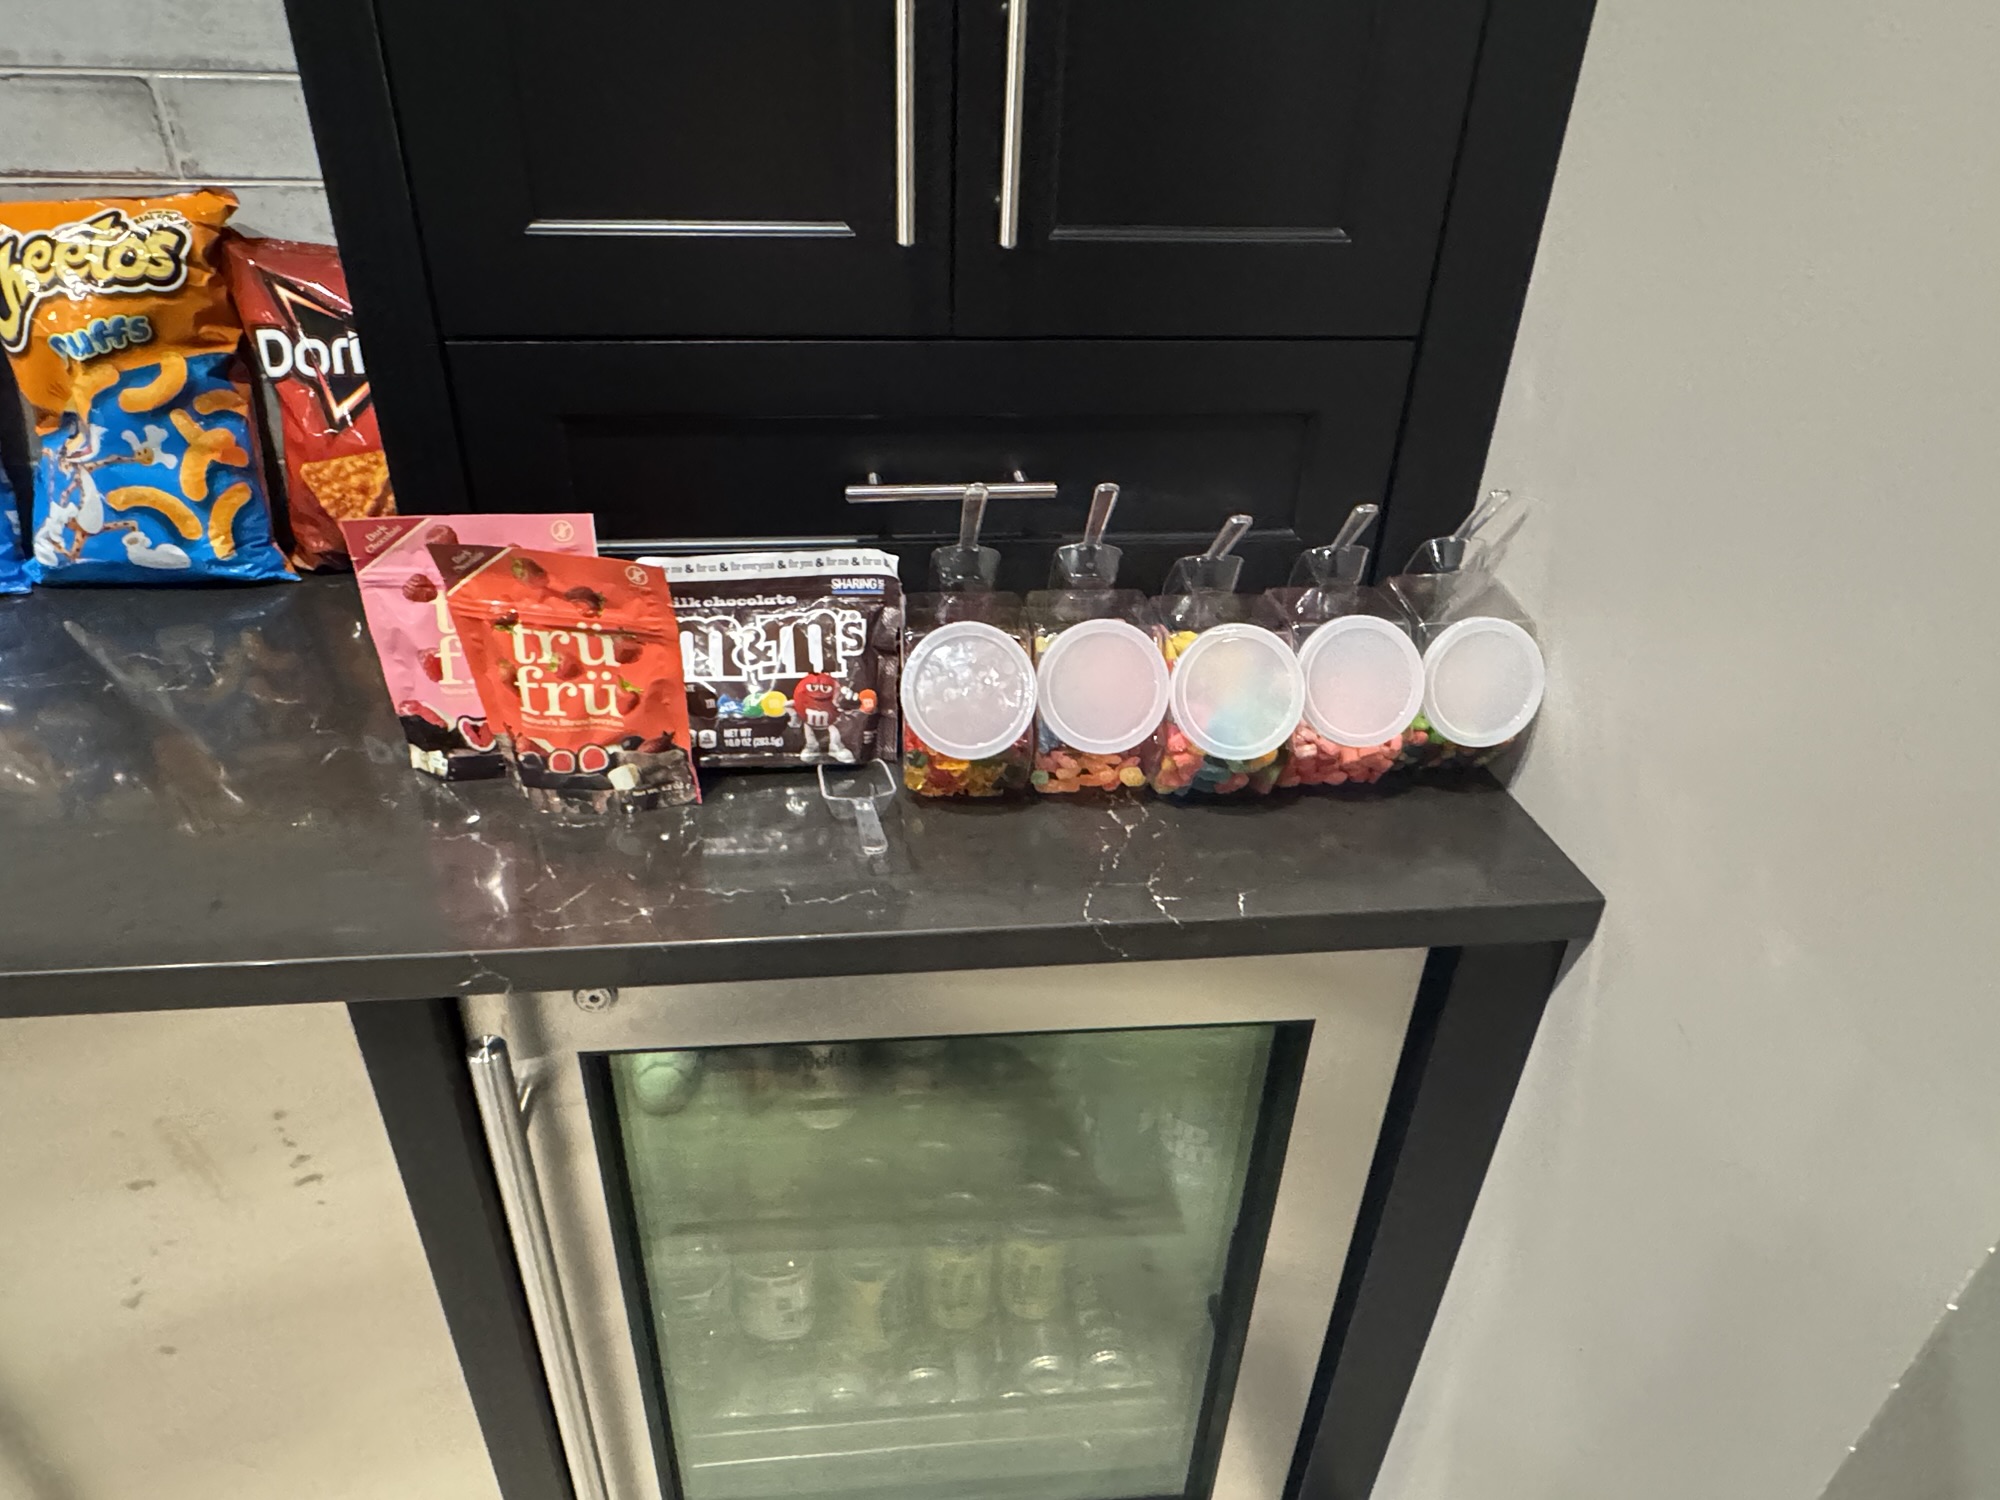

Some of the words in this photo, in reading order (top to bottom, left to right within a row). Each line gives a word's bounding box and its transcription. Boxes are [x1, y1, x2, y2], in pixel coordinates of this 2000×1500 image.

[0, 211, 185, 350] heetos
[255, 328, 365, 378] Dori
[685, 564, 694, 573] &
[719, 562, 728, 571] &
[777, 559, 786, 569] &
[815, 557, 824, 568] &
[850, 556, 860, 566] &
[831, 578, 878, 590] SHARING
[667, 595, 702, 608] ilk
[702, 593, 797, 608] chocolate
[512, 621, 622, 668] trü
[513, 664, 624, 719] frü
[723, 729, 739, 738] NET
